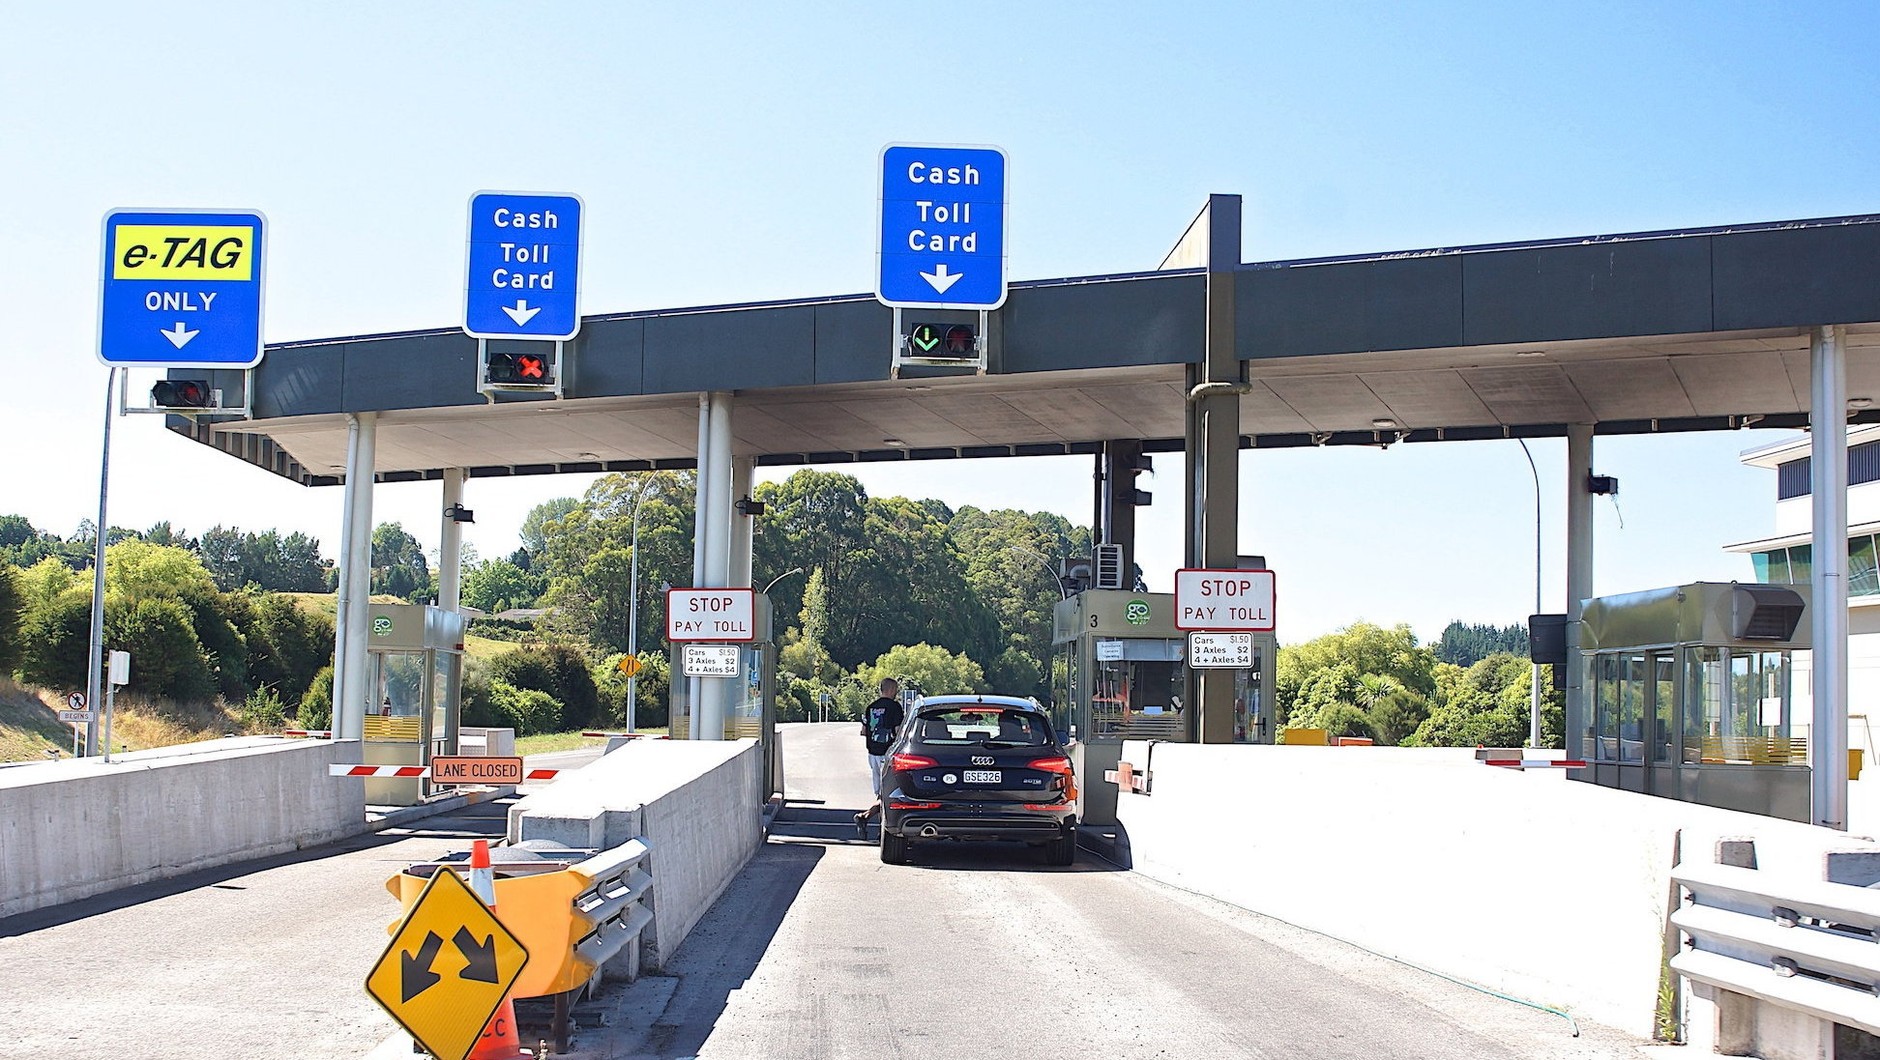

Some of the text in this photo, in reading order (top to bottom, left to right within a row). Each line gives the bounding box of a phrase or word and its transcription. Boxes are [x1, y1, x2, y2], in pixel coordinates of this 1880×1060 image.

[908, 161, 979, 185] Cash
[494, 208, 558, 229] Cash
[916, 201, 970, 223] Toll
[908, 229, 977, 253] Card
[123, 237, 243, 269] e-TAG
[500, 243, 549, 263] Toll
[492, 268, 554, 289] Card
[145, 291, 217, 311] ONLY
[1200, 580, 1251, 596] STOP
[689, 597, 733, 612] STOP
[1090, 614, 1098, 628] 3
[1184, 607, 1267, 620] PAY TOLL
[675, 621, 746, 632] PAY TOLL
[1194, 635, 1249, 645] Cars $1.50
[718, 648, 736, 656] $1.50
[1237, 645, 1248, 654] $2
[1237, 655, 1249, 664] $4
[435, 764, 517, 777] LANE CLOSED
[964, 772, 1001, 782] GSE326
